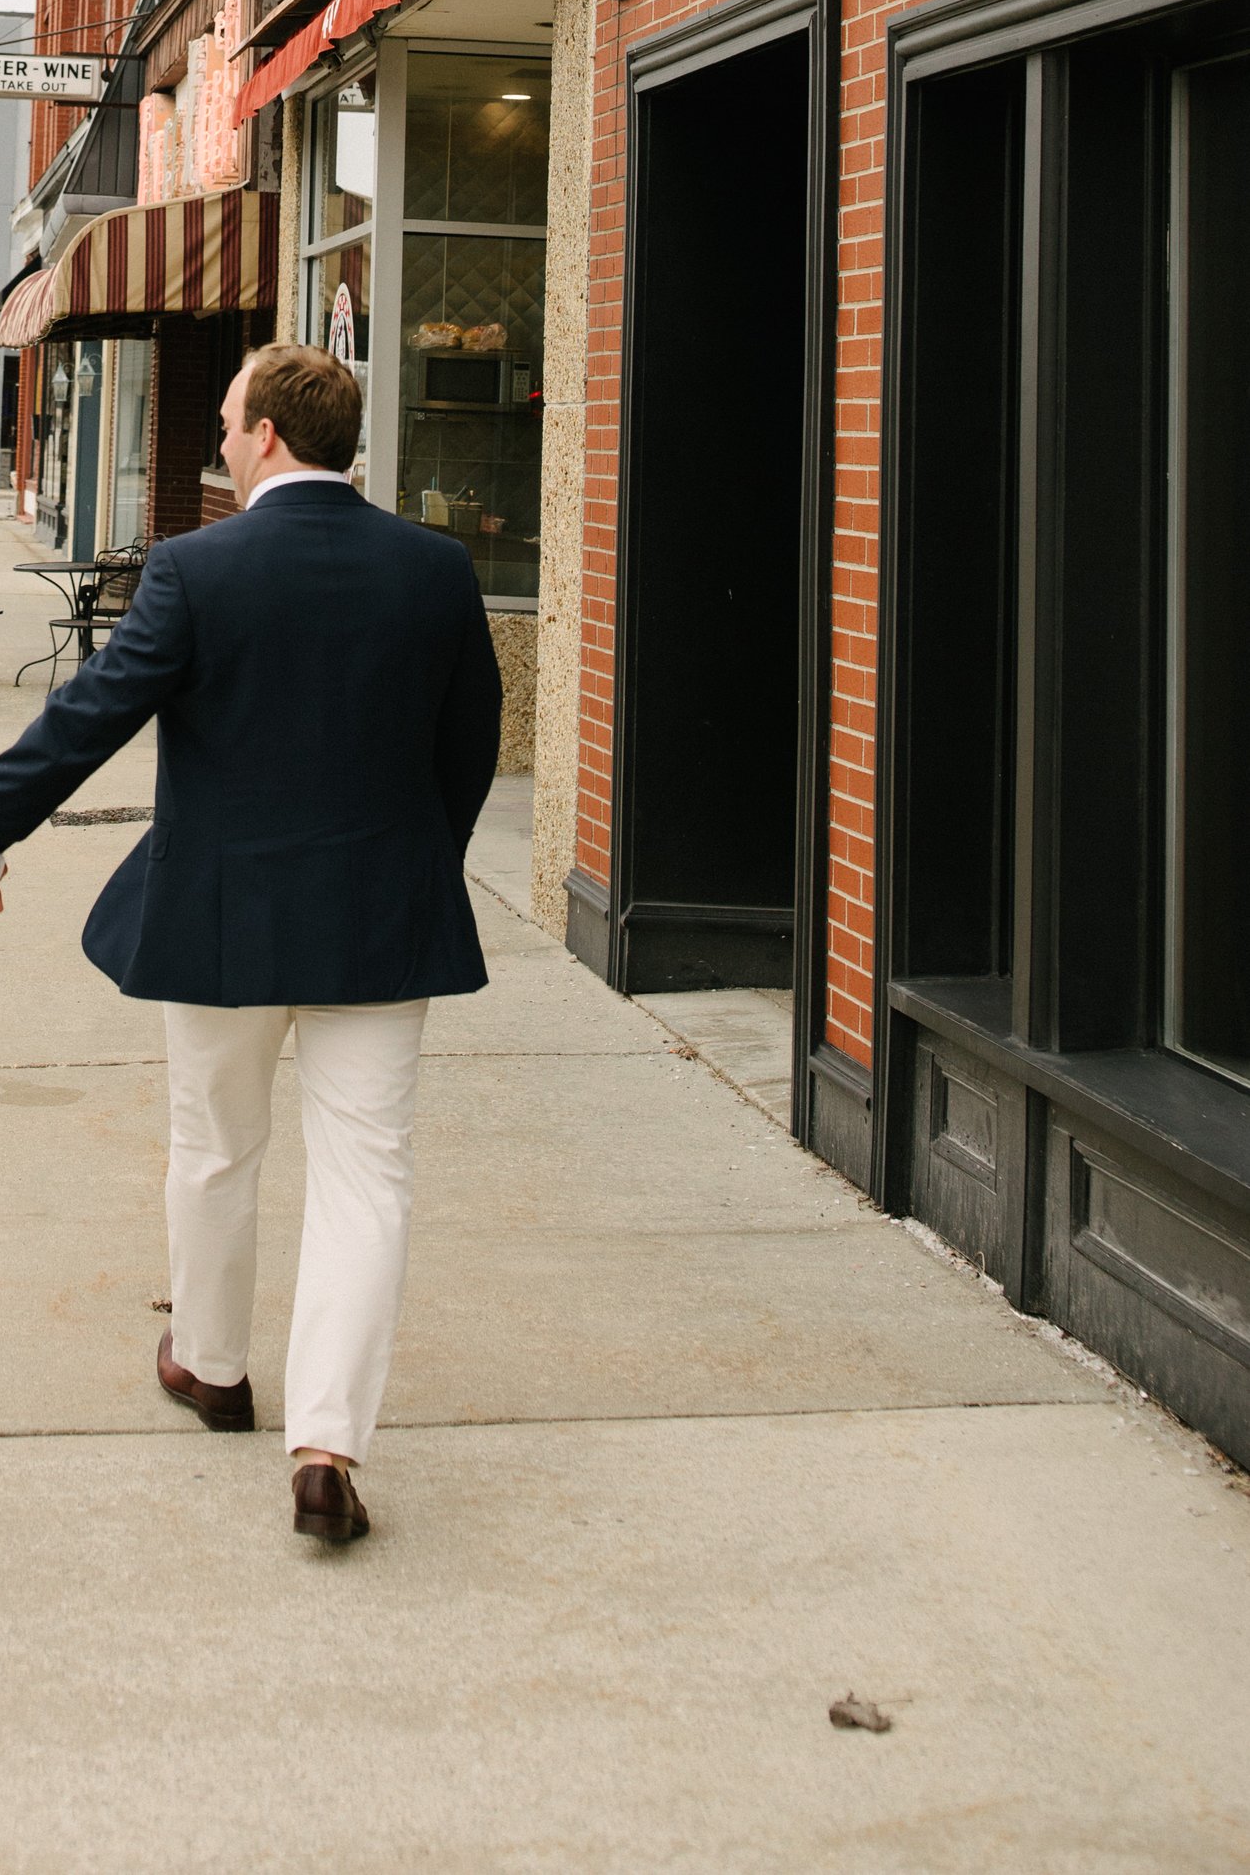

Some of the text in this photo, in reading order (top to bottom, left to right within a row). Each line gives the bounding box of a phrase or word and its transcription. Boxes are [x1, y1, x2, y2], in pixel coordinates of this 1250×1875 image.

[44, 62, 92, 79] WINE
[0, 80, 67, 92] TAKE OUT
